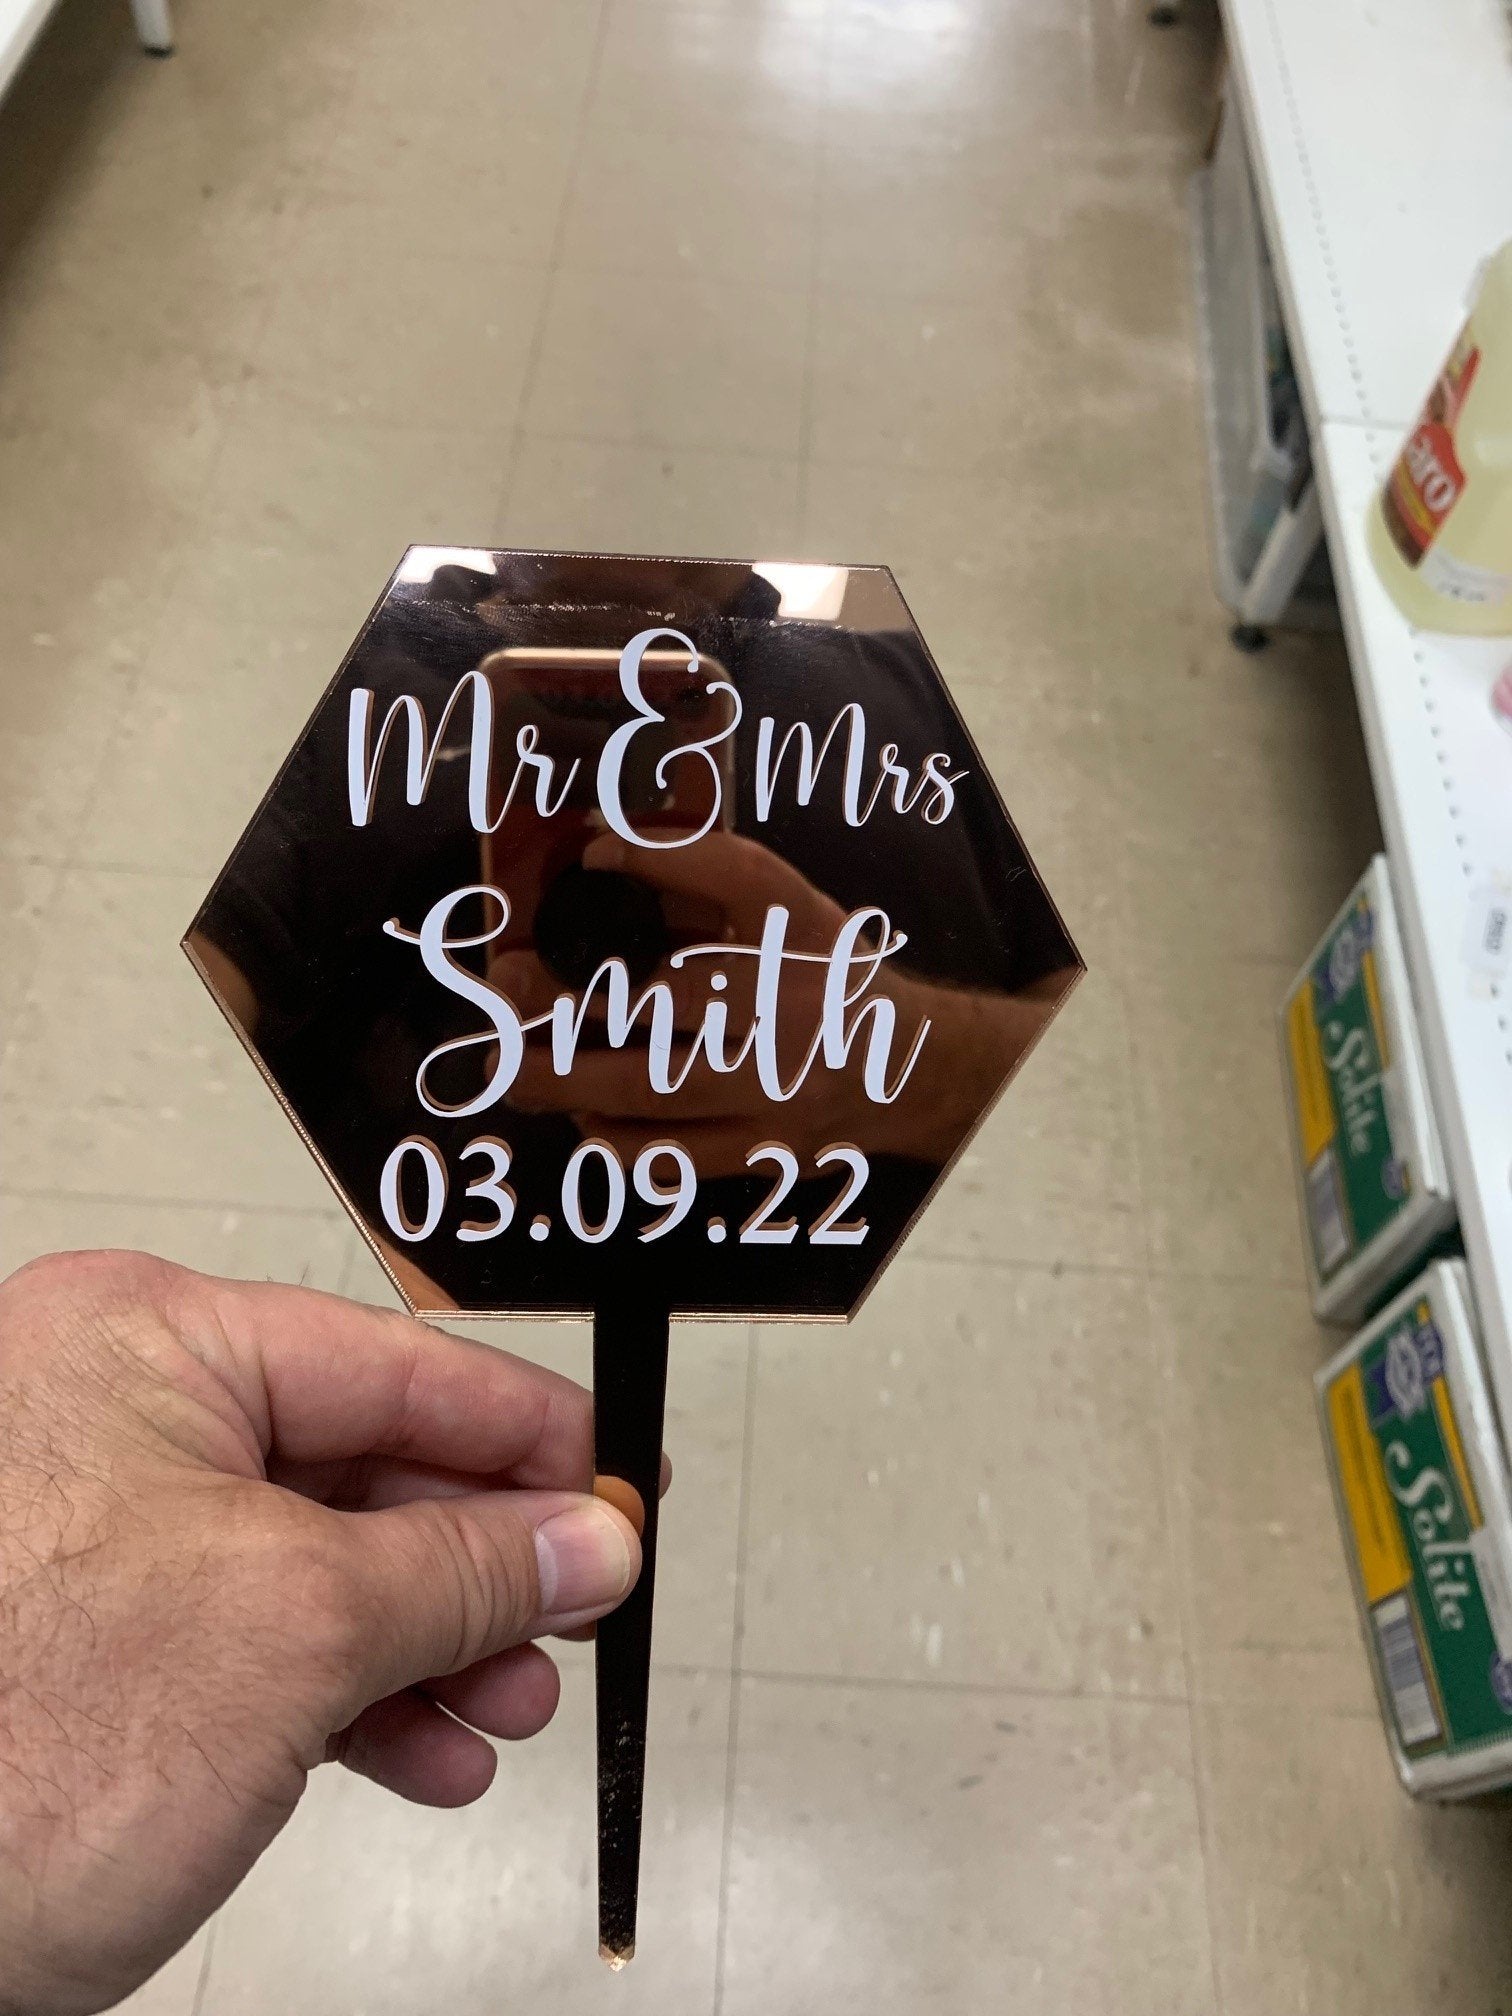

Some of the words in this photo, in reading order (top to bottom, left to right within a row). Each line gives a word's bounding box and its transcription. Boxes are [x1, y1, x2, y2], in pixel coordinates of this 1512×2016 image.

[347, 670, 581, 834] Mr
[596, 627, 743, 849] &
[755, 702, 970, 827] Mrs
[382, 886, 932, 1118] Smith
[379, 1137, 871, 1245] 03.09.22
